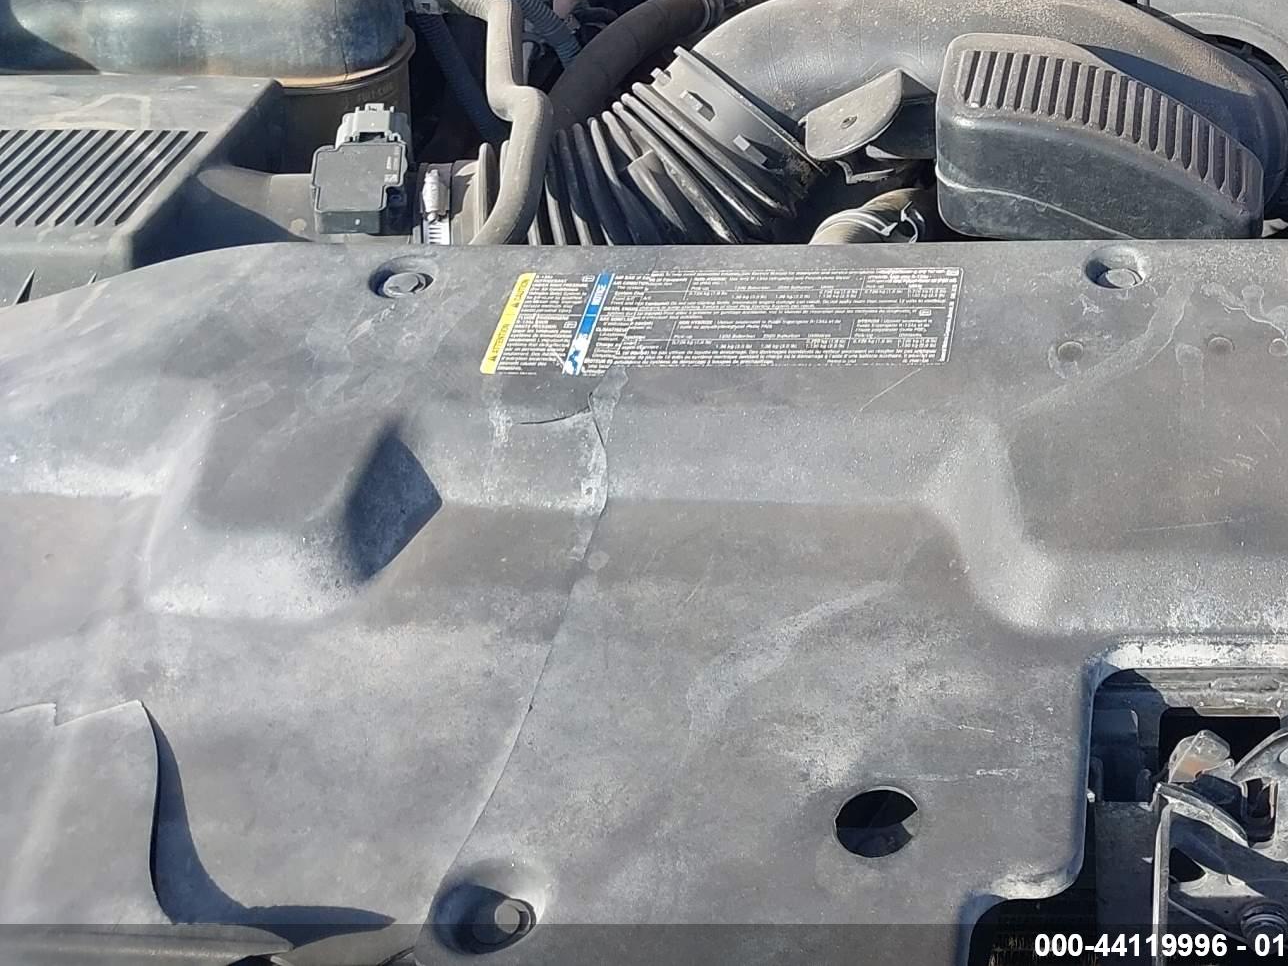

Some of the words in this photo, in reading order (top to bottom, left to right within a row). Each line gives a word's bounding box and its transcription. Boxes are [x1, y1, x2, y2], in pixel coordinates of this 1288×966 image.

[517, 278, 530, 302] CAUTION
[591, 284, 607, 305] NOTICE
[492, 323, 510, 356] ATTENTION
